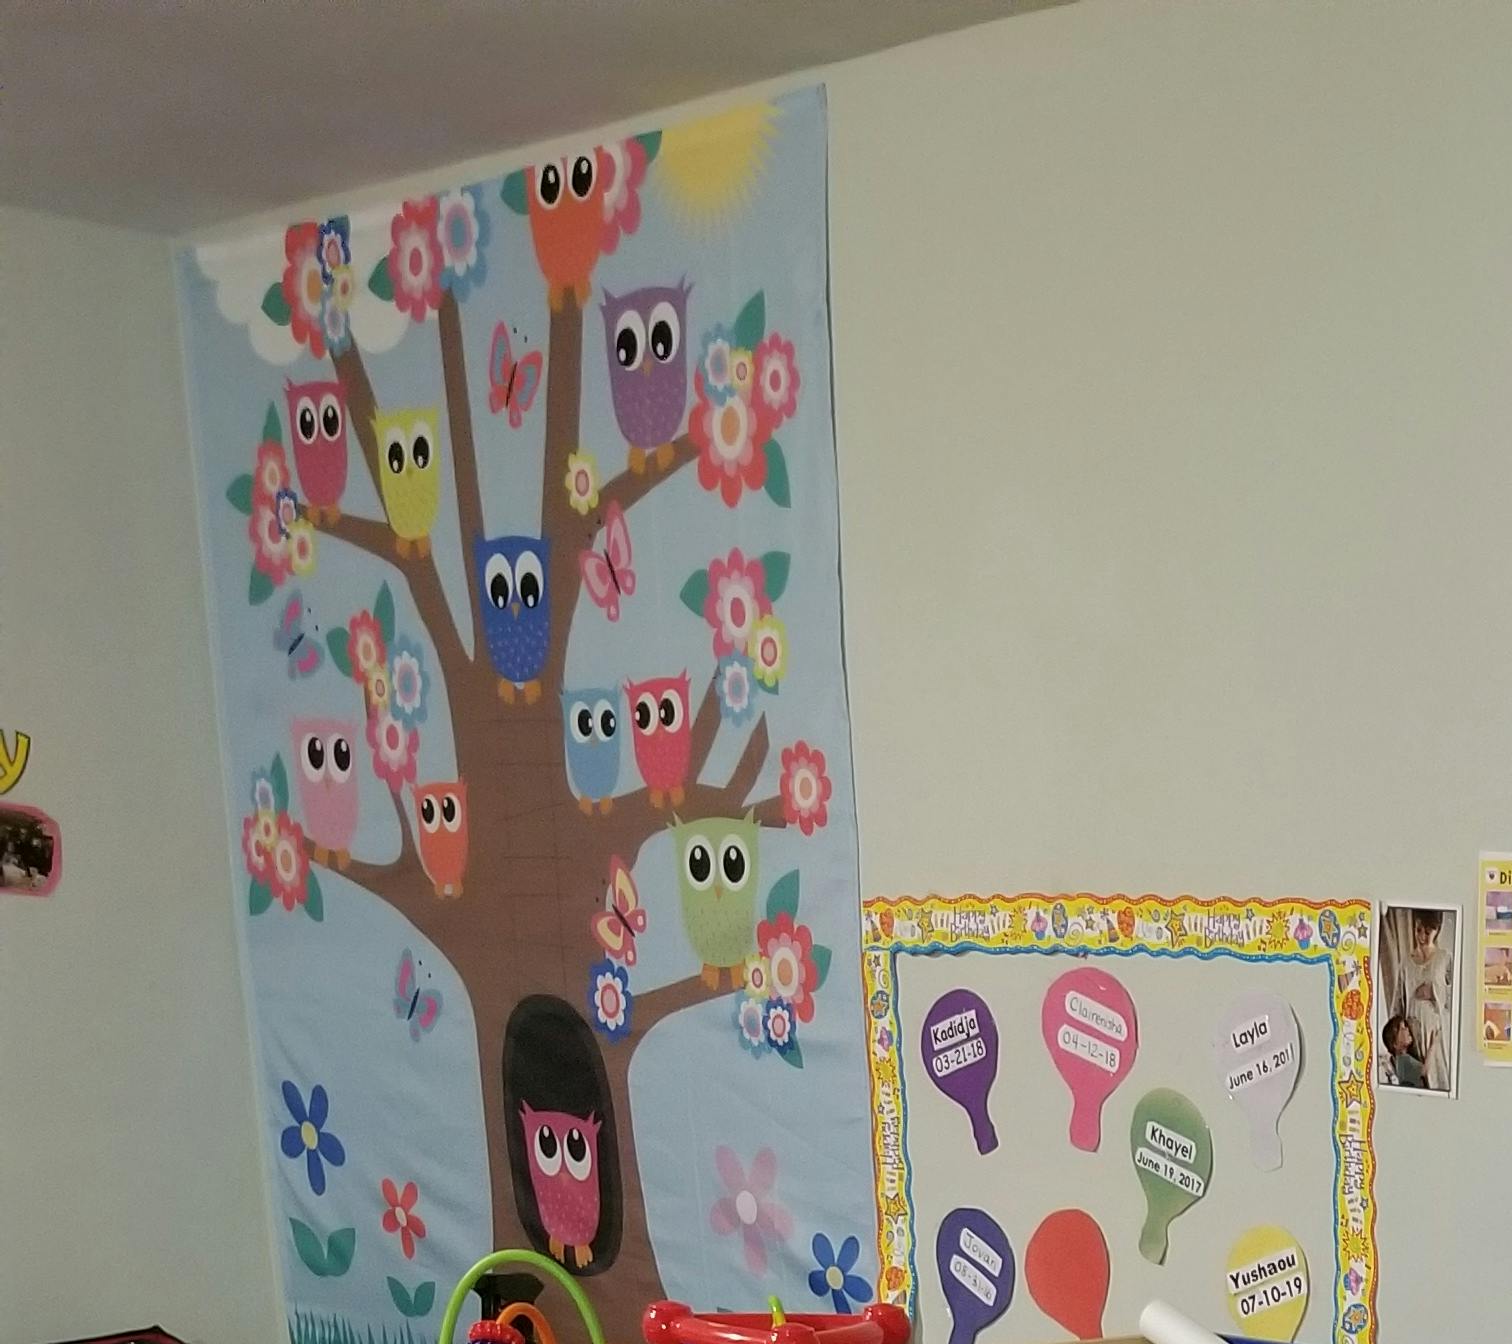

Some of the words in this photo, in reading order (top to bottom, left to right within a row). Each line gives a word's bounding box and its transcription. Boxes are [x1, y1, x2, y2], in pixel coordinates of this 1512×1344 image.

[932, 1015, 978, 1045] Kadidja
[1232, 1021, 1269, 1048] Layla
[935, 1041, 985, 1073] 03-21-18
[1062, 1034, 1117, 1069] 04-12-18
[1229, 1070, 1254, 1090] June
[1256, 1060, 1273, 1076] 16,
[1150, 1125, 1193, 1160] Khayel
[1136, 1151, 1161, 1173] June
[1164, 1164, 1178, 1183] 19,
[1179, 1173, 1202, 1194] 2017
[1229, 1253, 1297, 1290] Yushaou
[1240, 1276, 1303, 1316] 07-10-19
